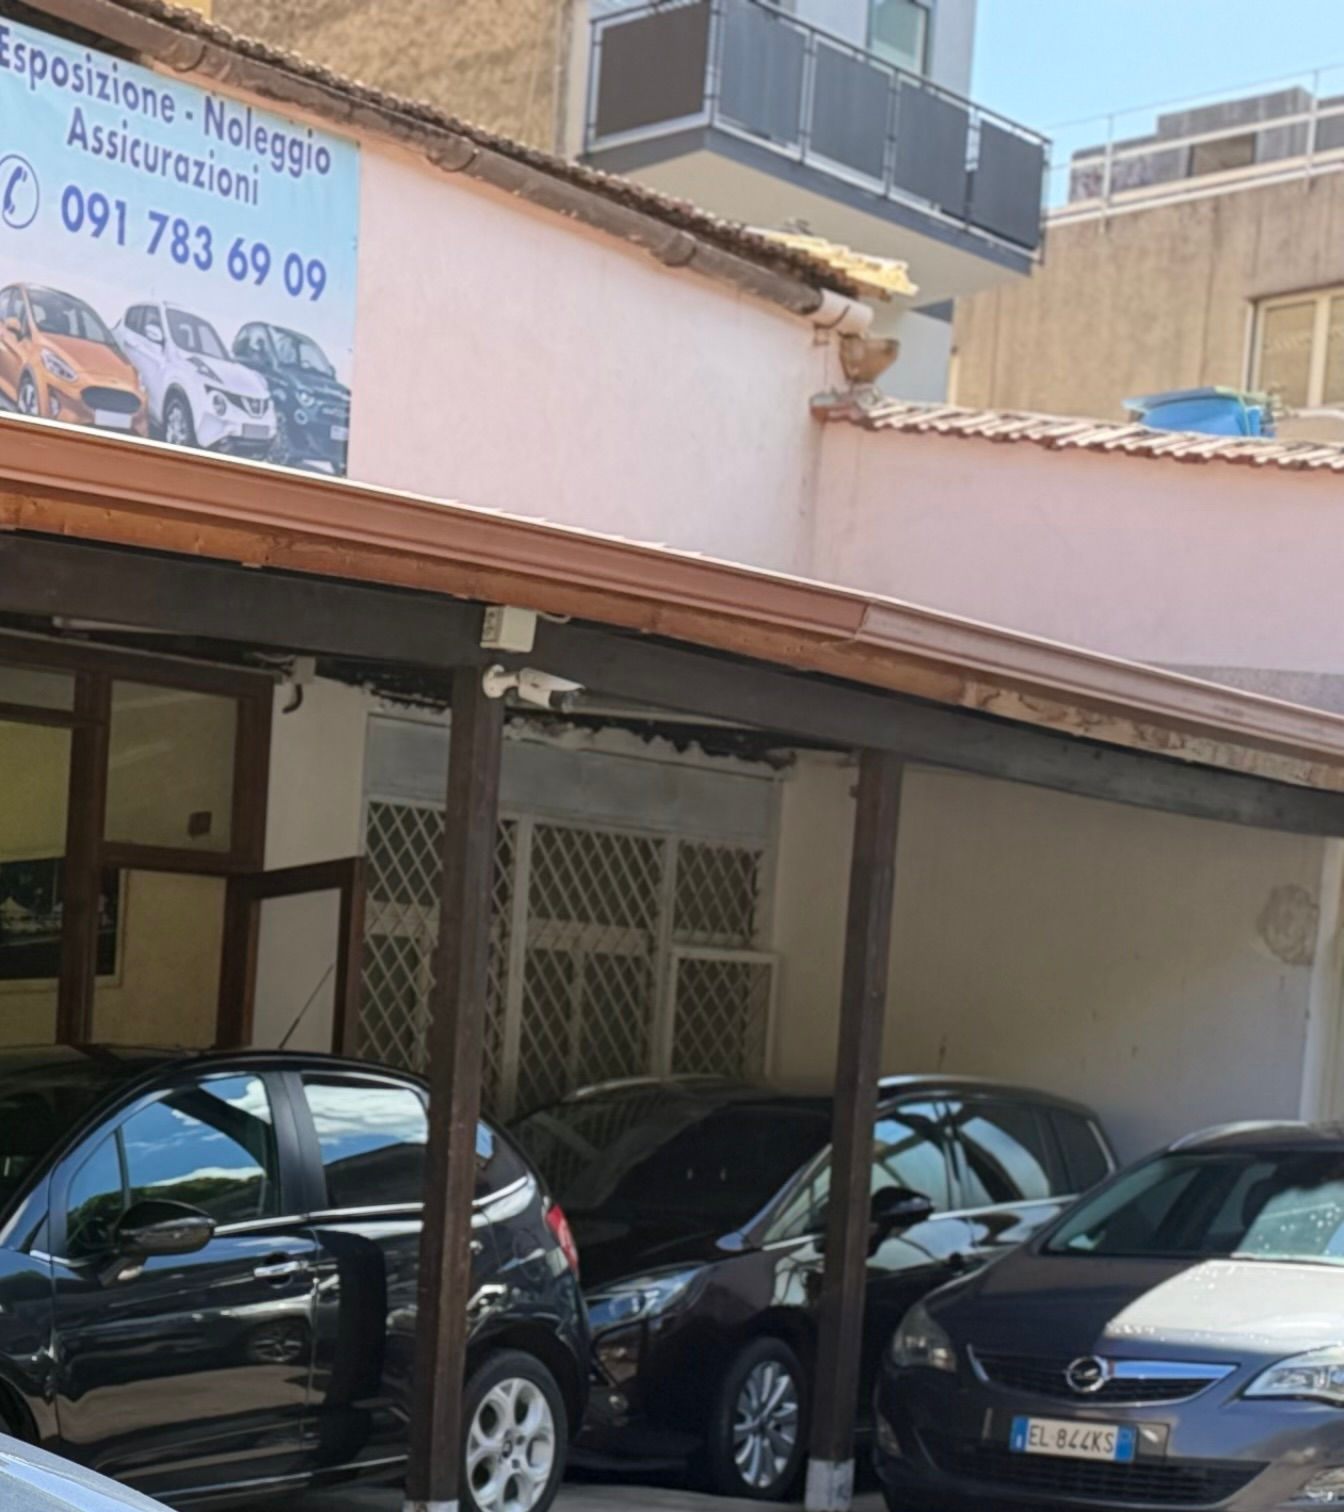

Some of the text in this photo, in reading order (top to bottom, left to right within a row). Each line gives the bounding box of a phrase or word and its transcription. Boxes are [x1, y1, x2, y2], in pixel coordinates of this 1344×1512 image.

[67, 107, 258, 206] Assicurazioni
[204, 95, 330, 178] Noleggio
[62, 185, 327, 302] 091 783 69 09
[1028, 1425, 1114, 1453] EL 844KS
